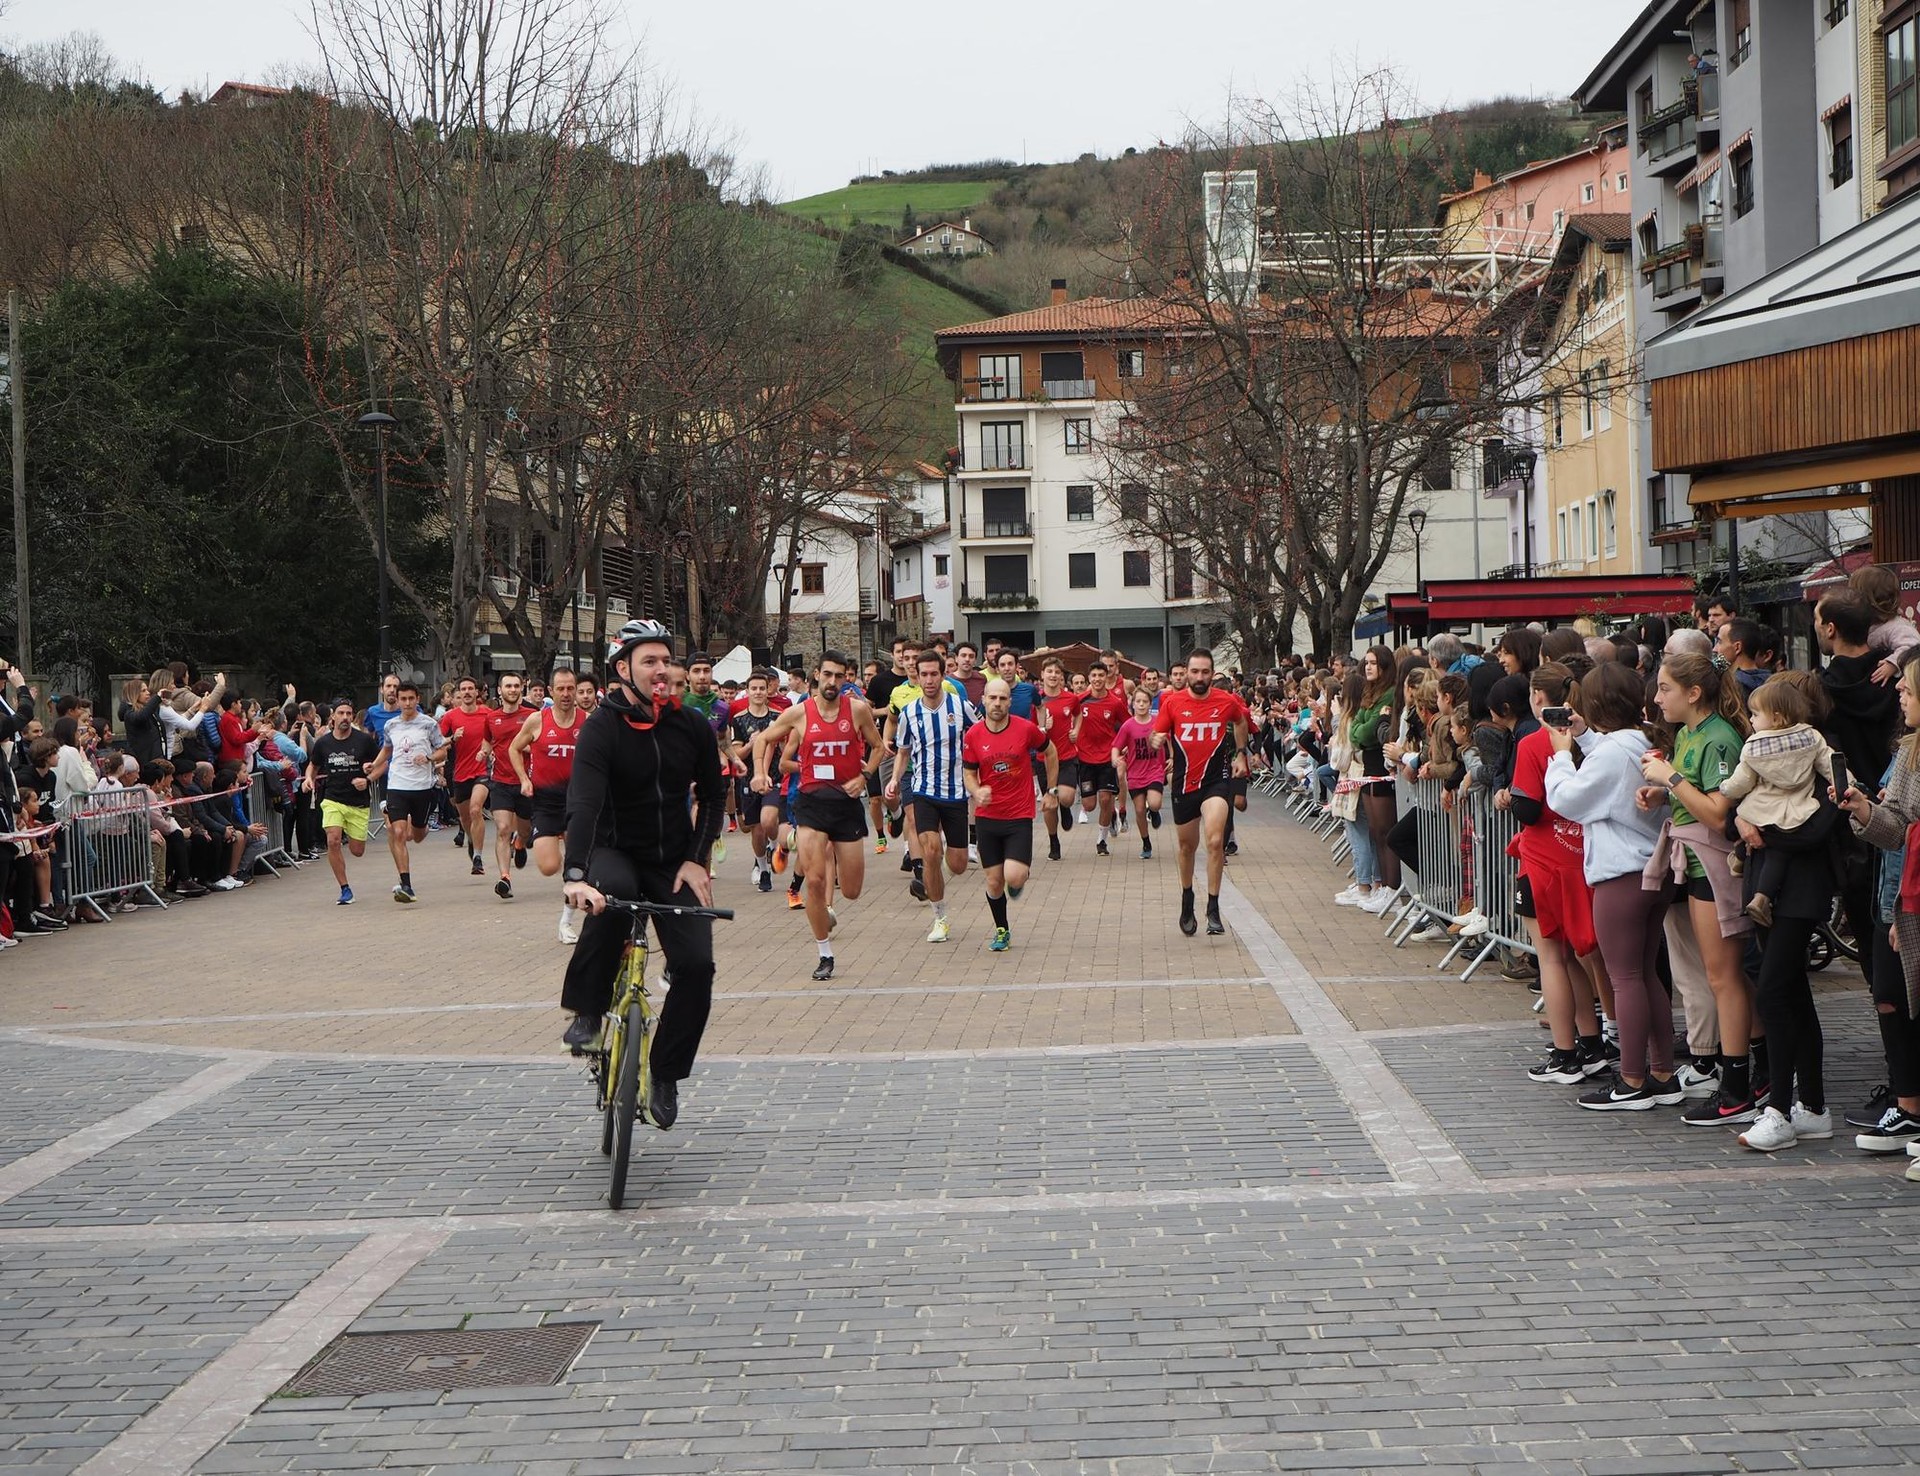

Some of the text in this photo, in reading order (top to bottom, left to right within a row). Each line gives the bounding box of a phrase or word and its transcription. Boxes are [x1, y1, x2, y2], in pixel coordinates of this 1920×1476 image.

[1082, 707, 1089, 717] 5
[1180, 722, 1221, 742] ZTT
[812, 741, 850, 757] ZTT
